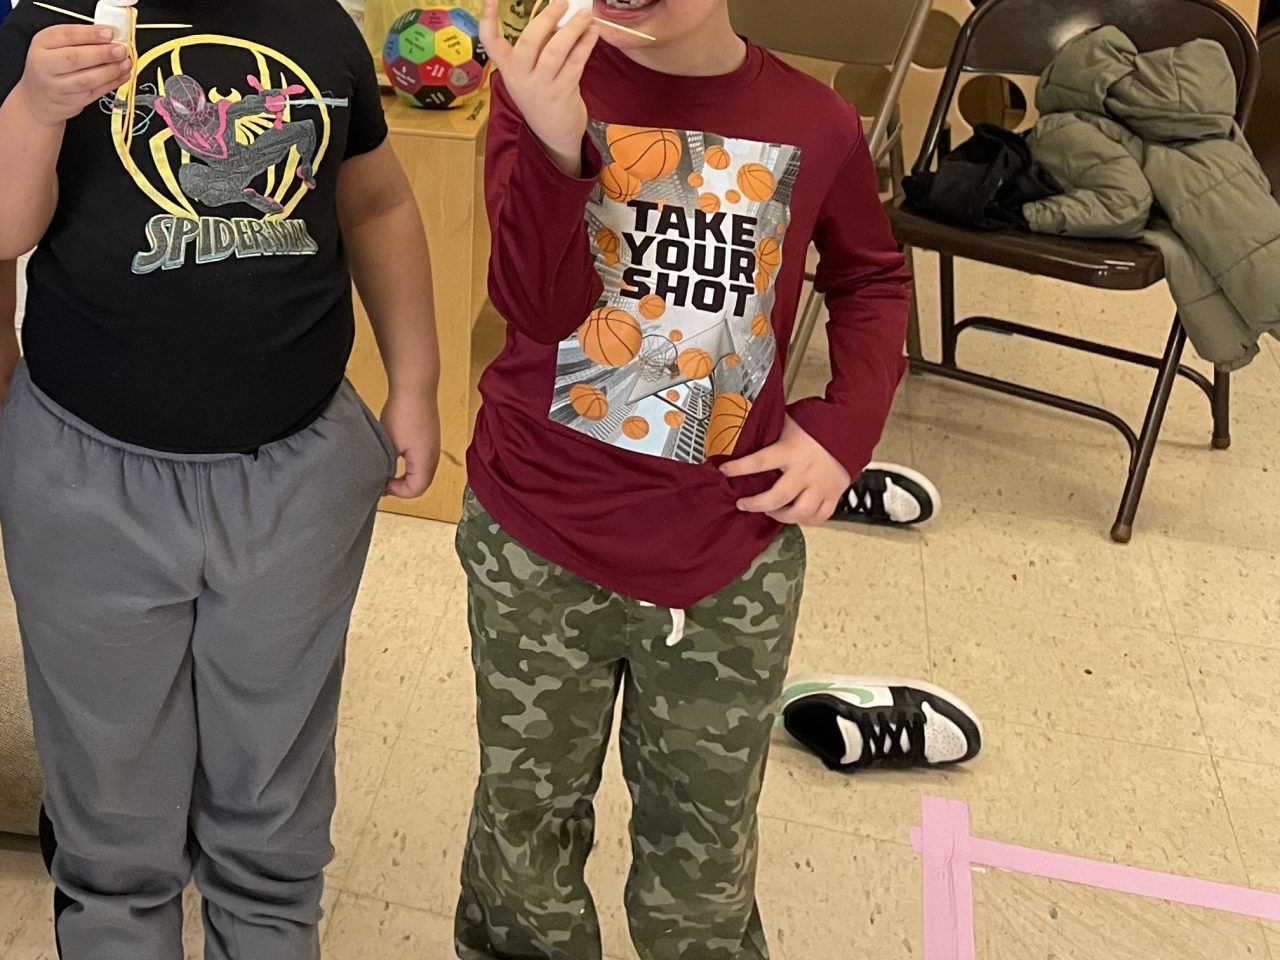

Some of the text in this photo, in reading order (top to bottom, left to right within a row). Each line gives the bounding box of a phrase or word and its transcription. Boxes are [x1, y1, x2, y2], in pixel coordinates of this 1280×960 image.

[626, 200, 758, 249] TAKE
[622, 231, 756, 284] YOUR
[620, 269, 755, 318] SHOT
